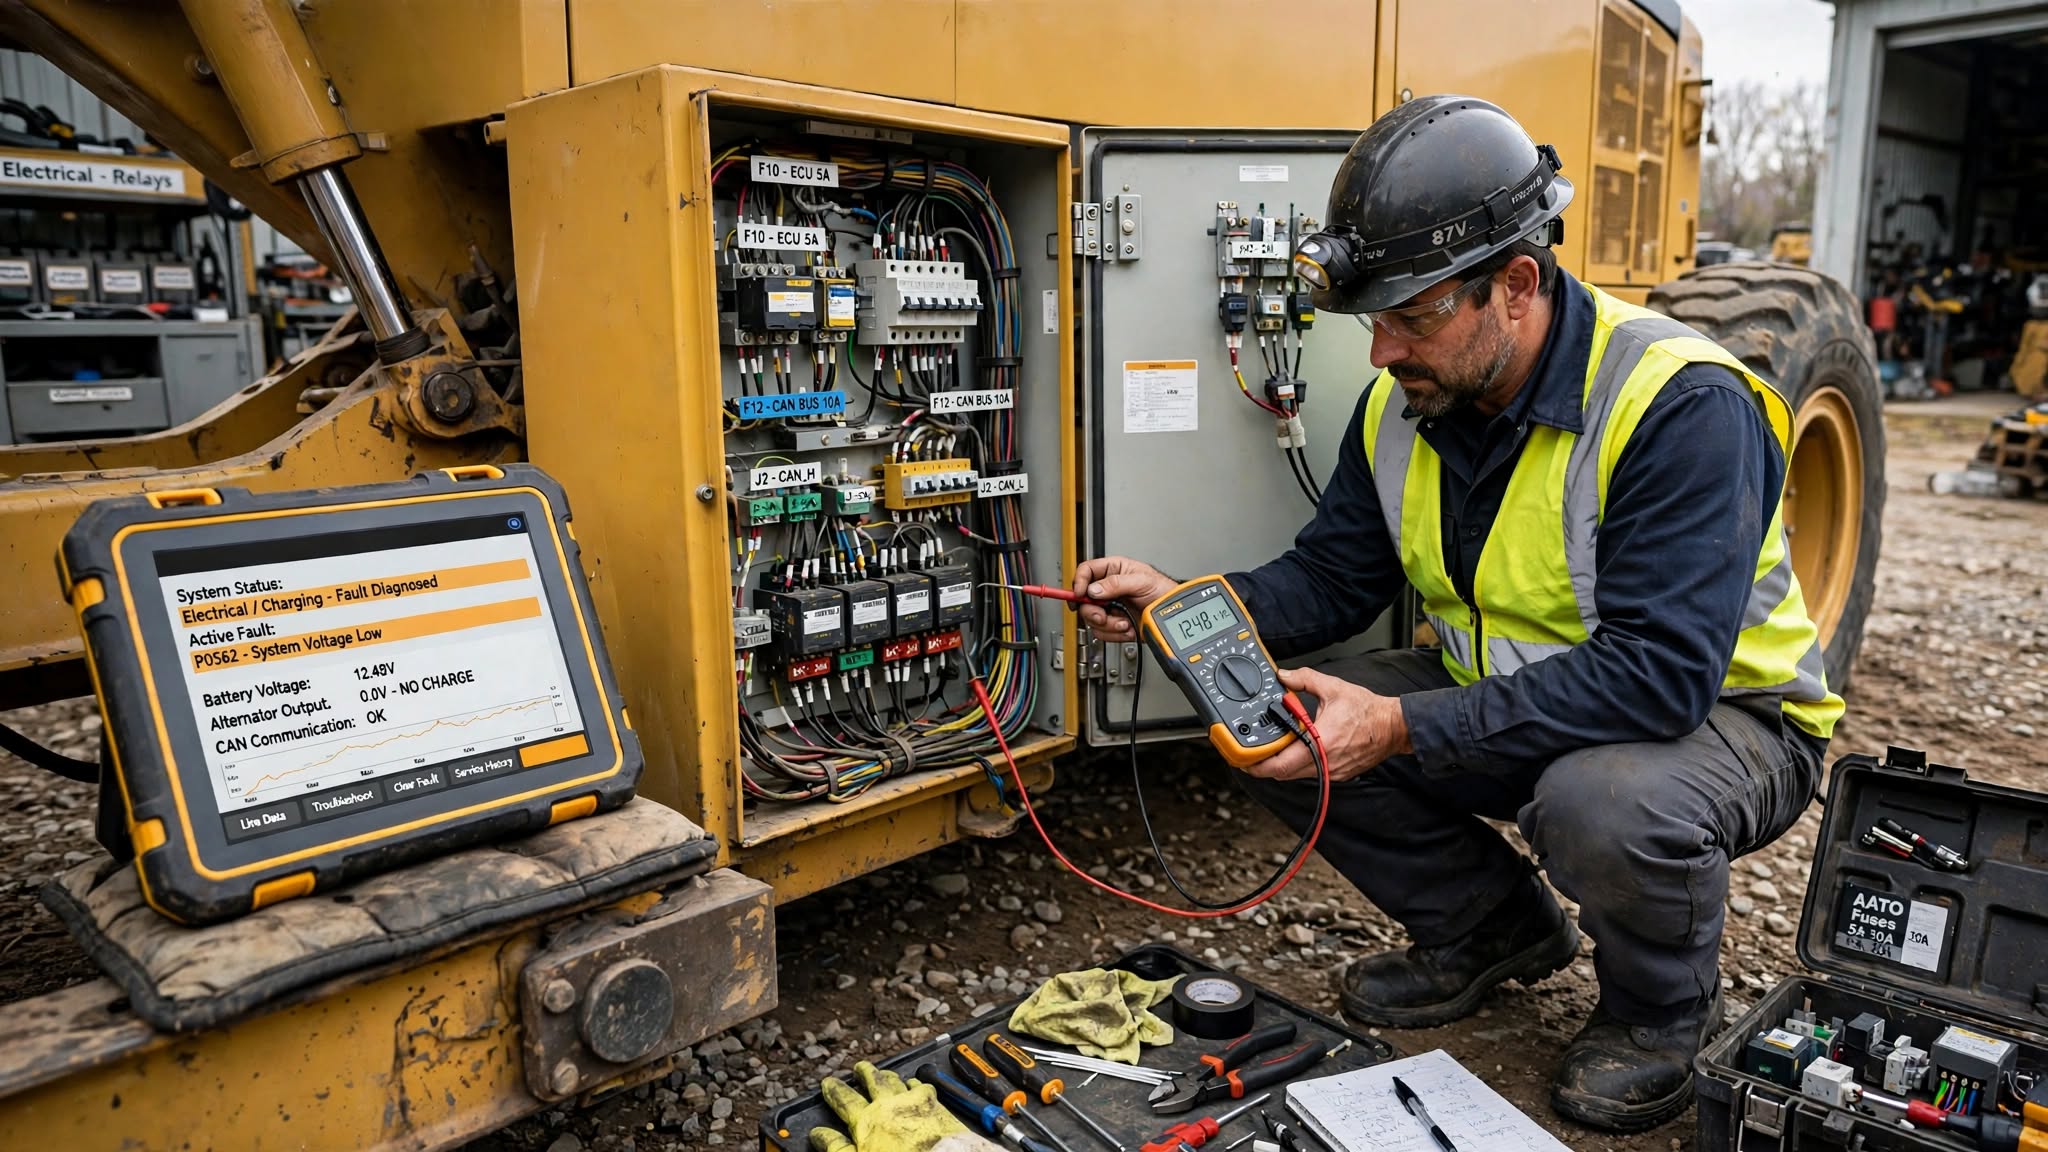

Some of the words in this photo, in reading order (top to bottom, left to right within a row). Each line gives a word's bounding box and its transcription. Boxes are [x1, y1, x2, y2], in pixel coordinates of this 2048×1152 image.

[2, 161, 93, 183] Electrical
[112, 169, 173, 190] Relays
[758, 162, 780, 176] F10
[790, 164, 813, 180] ECU
[816, 166, 830, 182] 5A
[744, 229, 765, 244] F10
[777, 231, 801, 246] ECU
[804, 232, 819, 246] 5A
[743, 399, 763, 414] F12
[772, 398, 796, 412] CAN
[799, 396, 820, 411] BUS
[823, 395, 841, 410] 10A
[933, 395, 950, 409] F12
[956, 394, 974, 407] CAN
[976, 393, 992, 406] BUS
[994, 392, 1011, 406] 10A
[754, 471, 769, 487] J2
[980, 481, 992, 494] J2
[176, 583, 231, 605] System
[234, 578, 284, 595] Status:
[181, 602, 249, 624] Electrical
[252, 601, 259, 615] /
[261, 593, 324, 613] Charging
[335, 585, 368, 602] Fault
[371, 574, 439, 597] Diagnosed
[189, 630, 235, 648] Active
[237, 622, 276, 639] Fault:
[251, 638, 301, 662] System
[303, 631, 353, 652] Voltage
[356, 627, 383, 645] Low
[202, 688, 253, 708] Battery
[254, 678, 311, 699] Voltage:
[210, 707, 278, 731] Alternator
[359, 685, 388, 703] 0.0V
[399, 680, 420, 696] NO
[421, 670, 475, 692] CHARGE
[215, 737, 248, 755] CAN
[250, 717, 357, 749] Communication:
[366, 708, 388, 725] OK
[1853, 892, 1904, 917] AATO
[1851, 908, 1897, 931] Fuses
